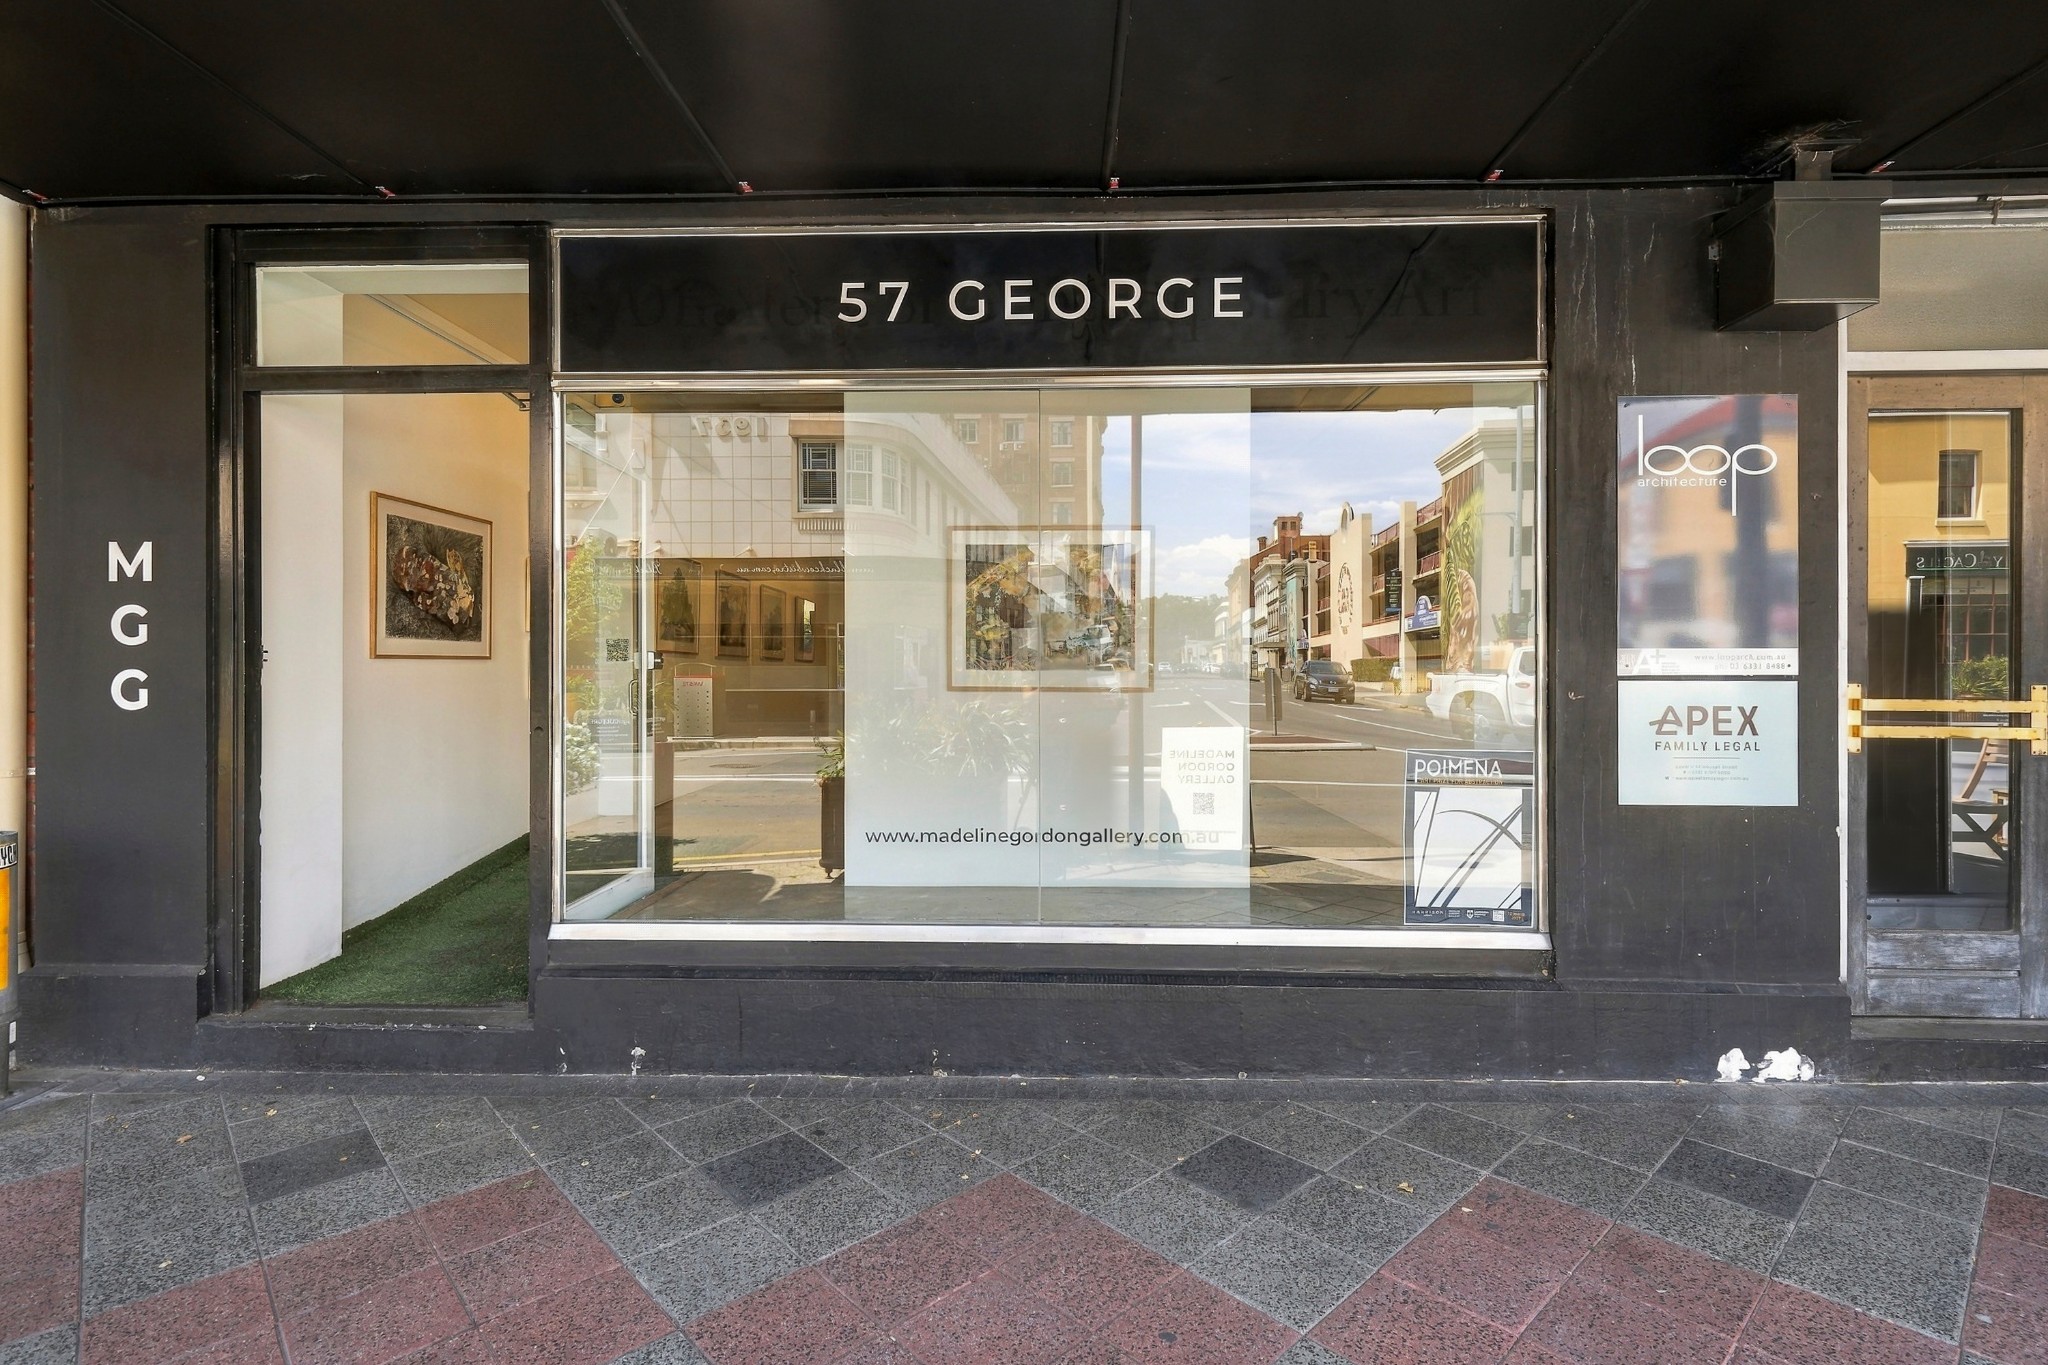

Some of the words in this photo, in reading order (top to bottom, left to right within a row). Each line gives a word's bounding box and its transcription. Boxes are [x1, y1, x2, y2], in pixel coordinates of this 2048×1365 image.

[838, 281, 910, 323] 57
[948, 276, 1246, 322] GEORGE
[1637, 414, 1778, 516] loop
[1637, 475, 1728, 488] architecture
[1649, 705, 1759, 736] APEX
[1655, 741, 1708, 751] FAMILY
[1715, 741, 1761, 751] LEGAL
[1414, 758, 1503, 783] POIMENA
[864, 826, 1220, 848] www.madelinegordongallery.com.au
